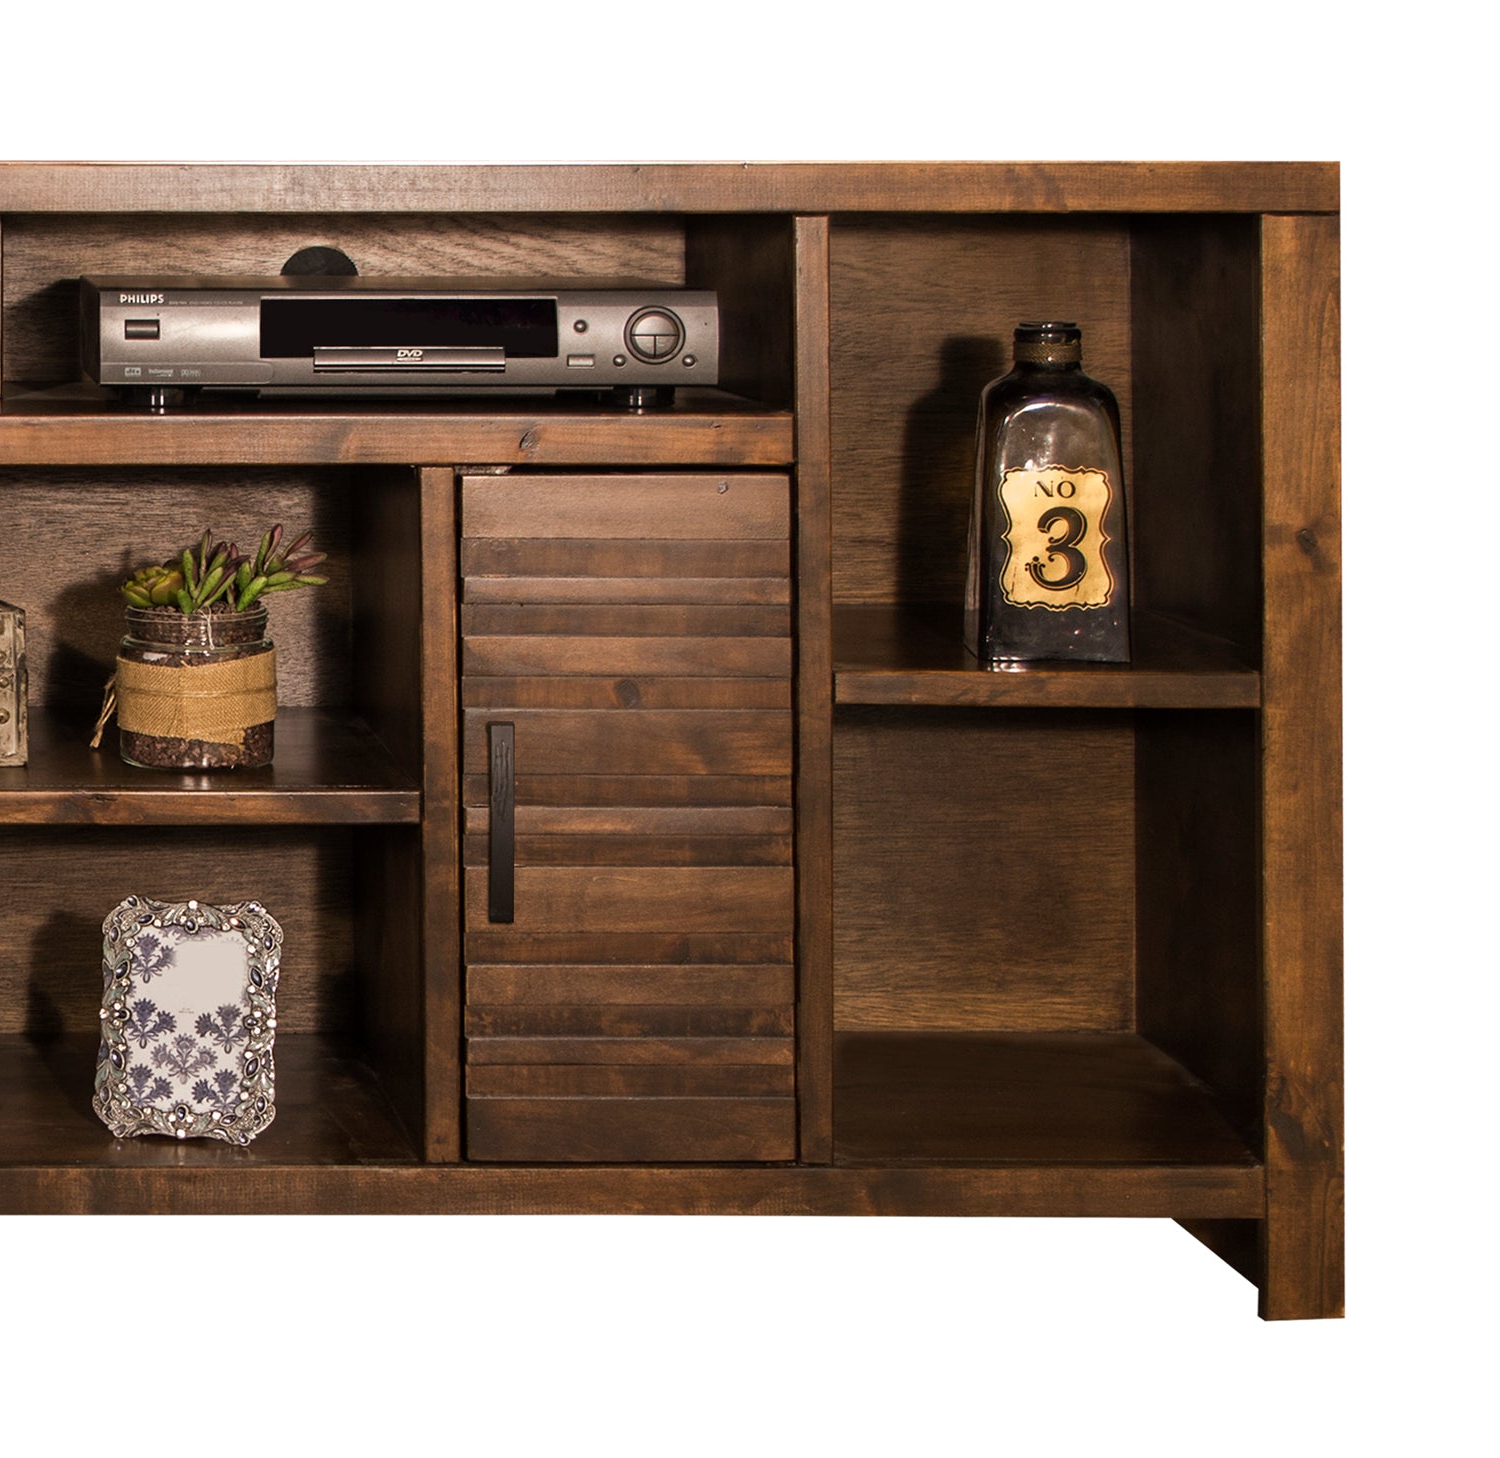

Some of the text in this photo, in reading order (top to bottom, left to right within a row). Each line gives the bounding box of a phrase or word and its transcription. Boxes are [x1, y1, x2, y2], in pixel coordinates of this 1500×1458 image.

[120, 294, 164, 304] PHILIPS
[1034, 481, 1076, 499] NO
[1025, 506, 1088, 591] 3
